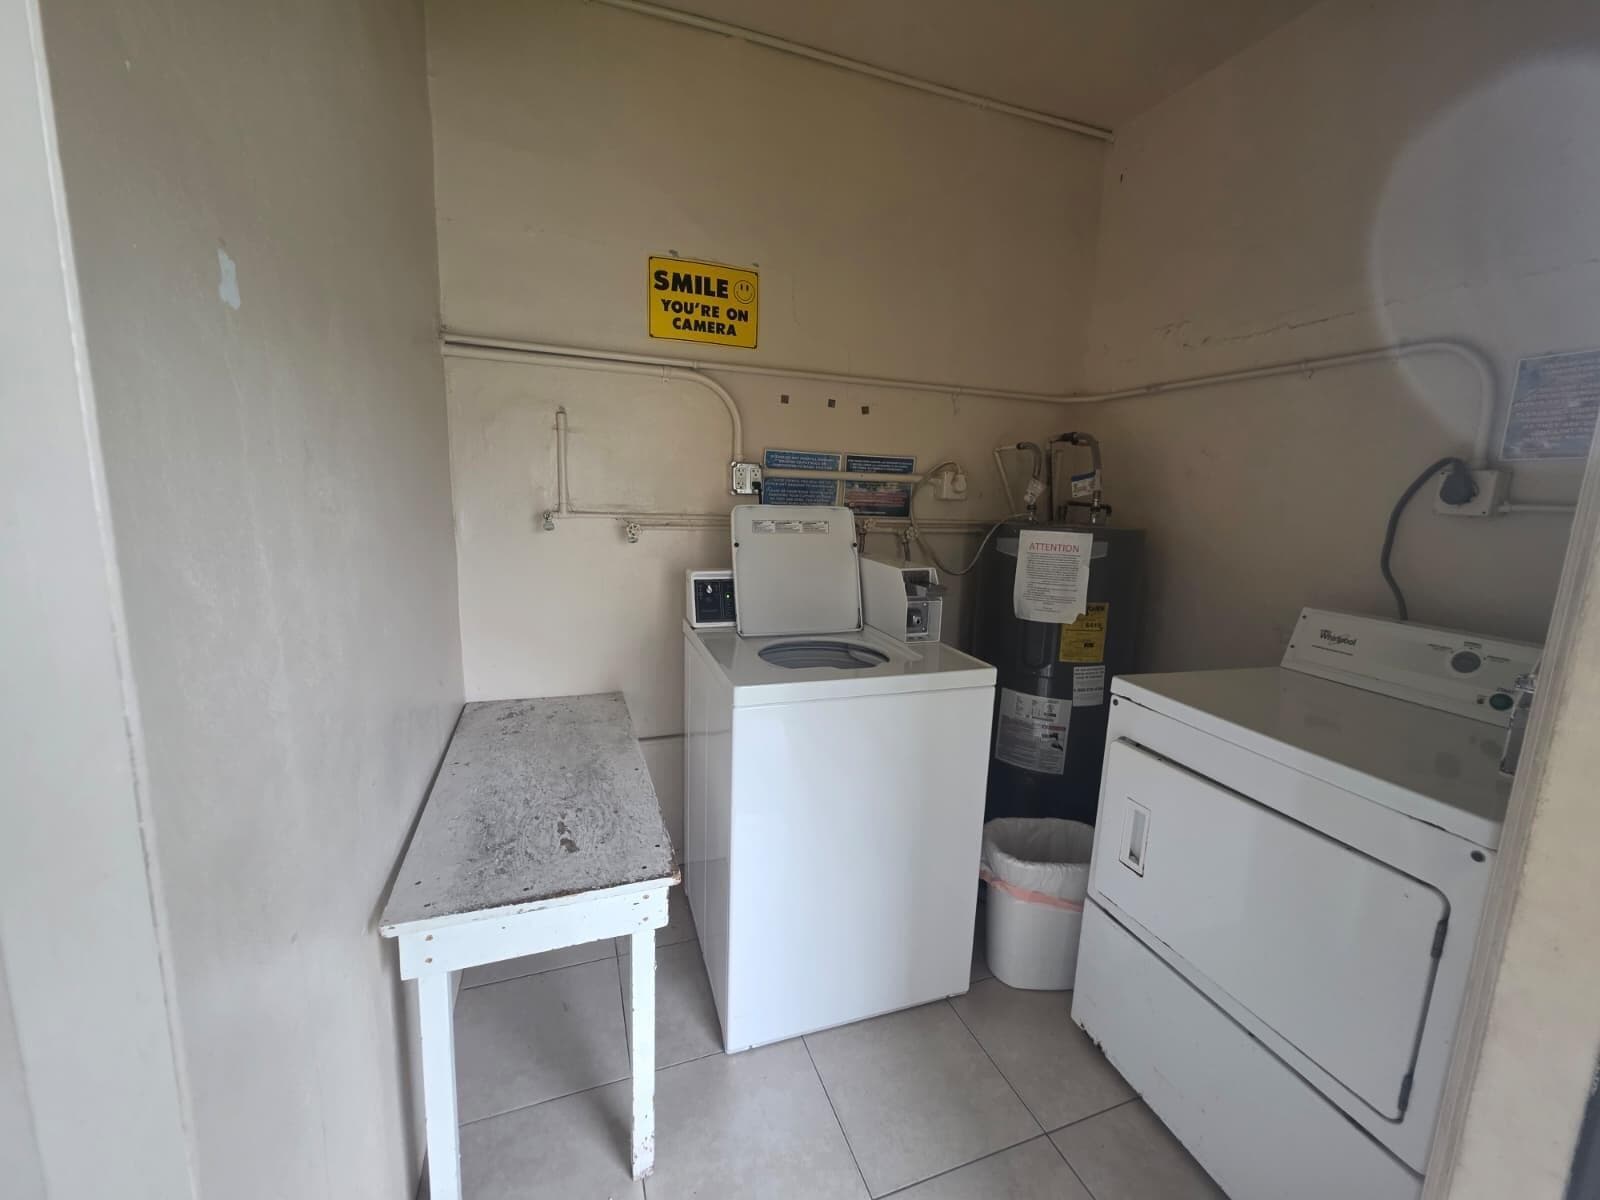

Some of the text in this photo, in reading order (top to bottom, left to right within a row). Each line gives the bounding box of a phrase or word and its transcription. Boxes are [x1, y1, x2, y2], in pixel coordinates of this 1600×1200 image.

[654, 269, 728, 299] SMILE
[661, 298, 748, 322] YOU'RE ON
[672, 317, 736, 336] CAMERA
[1029, 542, 1079, 553] ATTENTION
[1320, 630, 1356, 646] Whirlpool
